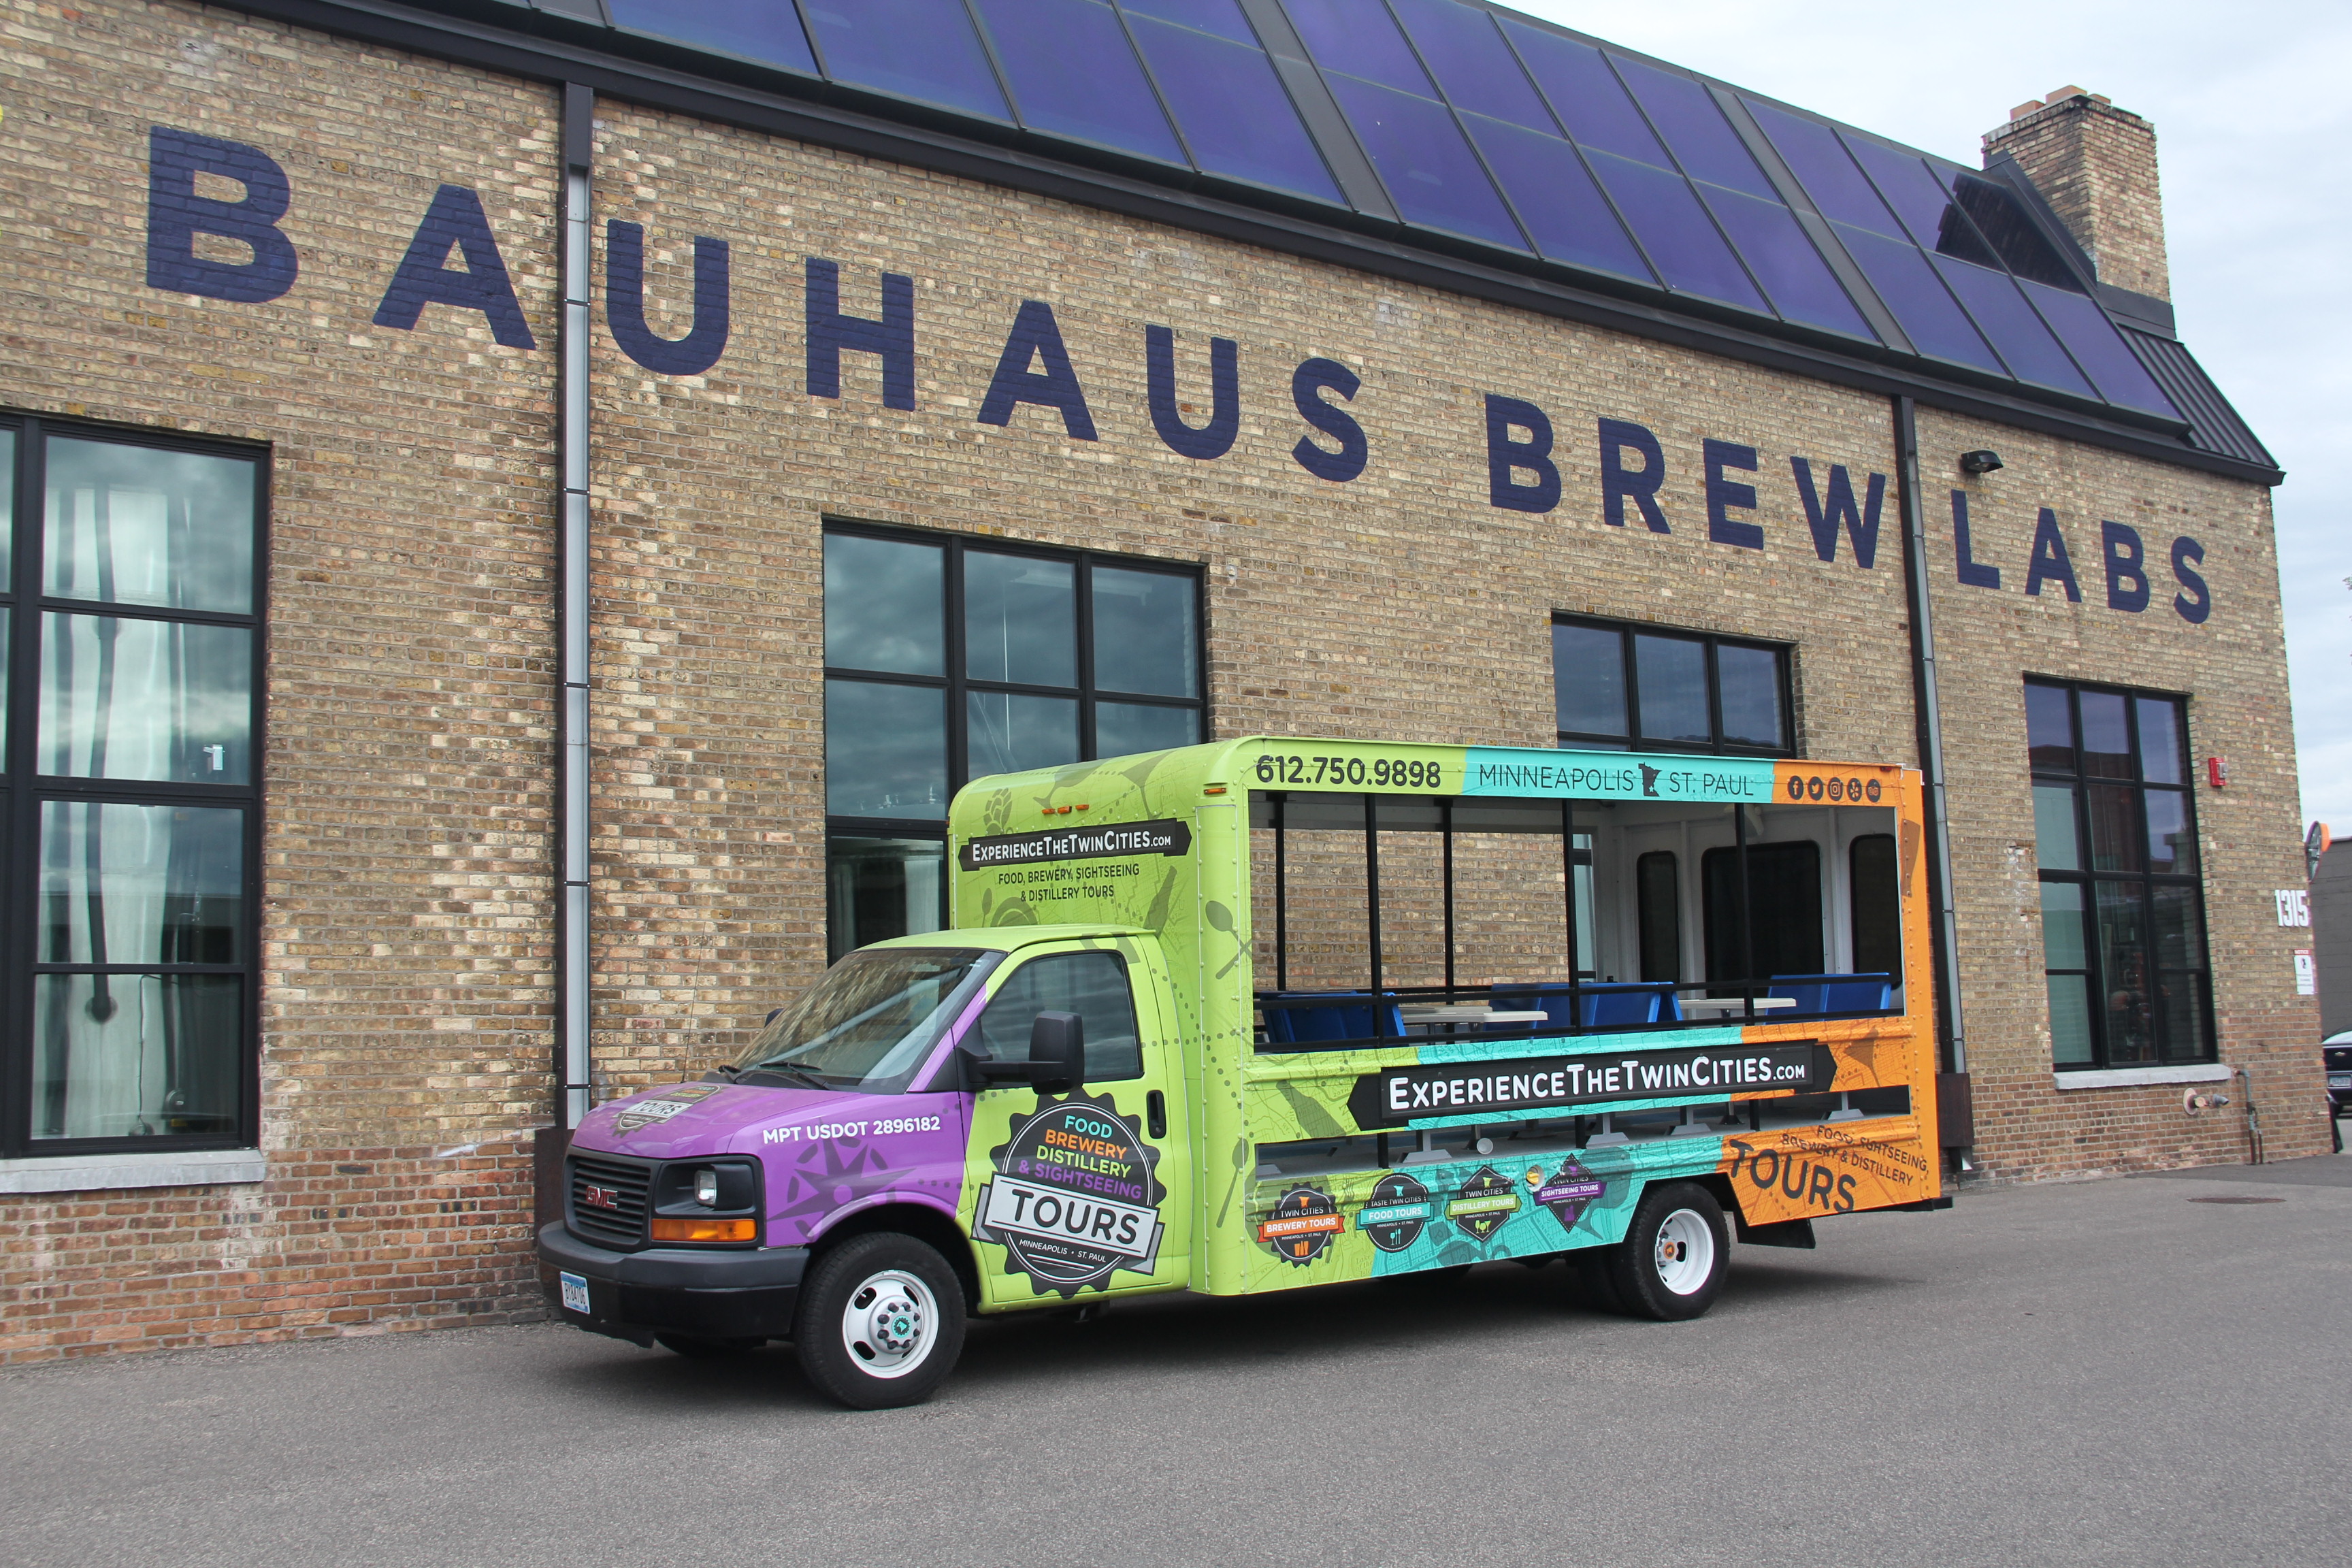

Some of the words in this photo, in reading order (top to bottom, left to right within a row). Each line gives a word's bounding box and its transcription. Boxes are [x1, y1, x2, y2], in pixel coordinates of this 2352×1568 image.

[146, 125, 1369, 483] BAUHAUS
[1484, 393, 1886, 569] BREW
[1950, 488, 2211, 624] LABS
[1256, 755, 1441, 788] 612.750.9898
[1480, 764, 1634, 791] MINNEAPOLIS
[1669, 772, 1696, 794] ST.
[1703, 773, 1754, 796] PAUL
[998, 872, 1025, 885] FOOD,
[1028, 869, 1073, 883] BREWERY,
[1076, 864, 1140, 879] SIGHTSEEING
[1021, 893, 1026, 902] &
[1028, 887, 1079, 902] DISTILLERY
[1083, 885, 1114, 898] TOURS
[2274, 889, 2309, 927] 1315
[634, 1102, 683, 1115] TOURS
[762, 1126, 802, 1144] MPT
[806, 1121, 868, 1140] USDOT
[872, 1115, 941, 1135] 2896182
[1064, 1115, 1113, 1139] FOOD
[1045, 1129, 1127, 1160] BREWERY
[1860, 1137, 1929, 1175] SIGHTSEEING,
[1036, 1145, 1132, 1178] DISTILLERY
[1782, 1133, 1838, 1158] BREWERY
[1840, 1150, 1848, 1162] &
[1851, 1152, 1914, 1186] DISTILLERY
[1018, 1160, 1029, 1175] &
[1034, 1163, 1142, 1199] SIGHTSEEING
[1729, 1139, 1857, 1212] TOURS
[586, 1186, 618, 1209] GMC
[1465, 1190, 1482, 1198] TWIN
[1484, 1188, 1503, 1196] CITIES
[1541, 1187, 1578, 1197] SIGHTSEEING
[1580, 1184, 1598, 1192] TOURS
[1011, 1188, 1140, 1245] TOURS
[1281, 1209, 1299, 1218] TWIN
[1301, 1207, 1324, 1215] CITIES
[1369, 1211, 1392, 1220] FOOD
[1395, 1207, 1422, 1217] TOURS
[1452, 1200, 1490, 1211] DISTILLERY
[1492, 1198, 1514, 1207] TOURS
[1267, 1220, 1307, 1232] BREWERY
[1308, 1218, 1335, 1228] TOURS
[1019, 1239, 1068, 1255] MINNEAPOLIS
[1077, 1250, 1087, 1259] ST.
[1088, 1252, 1107, 1262] PAUL
